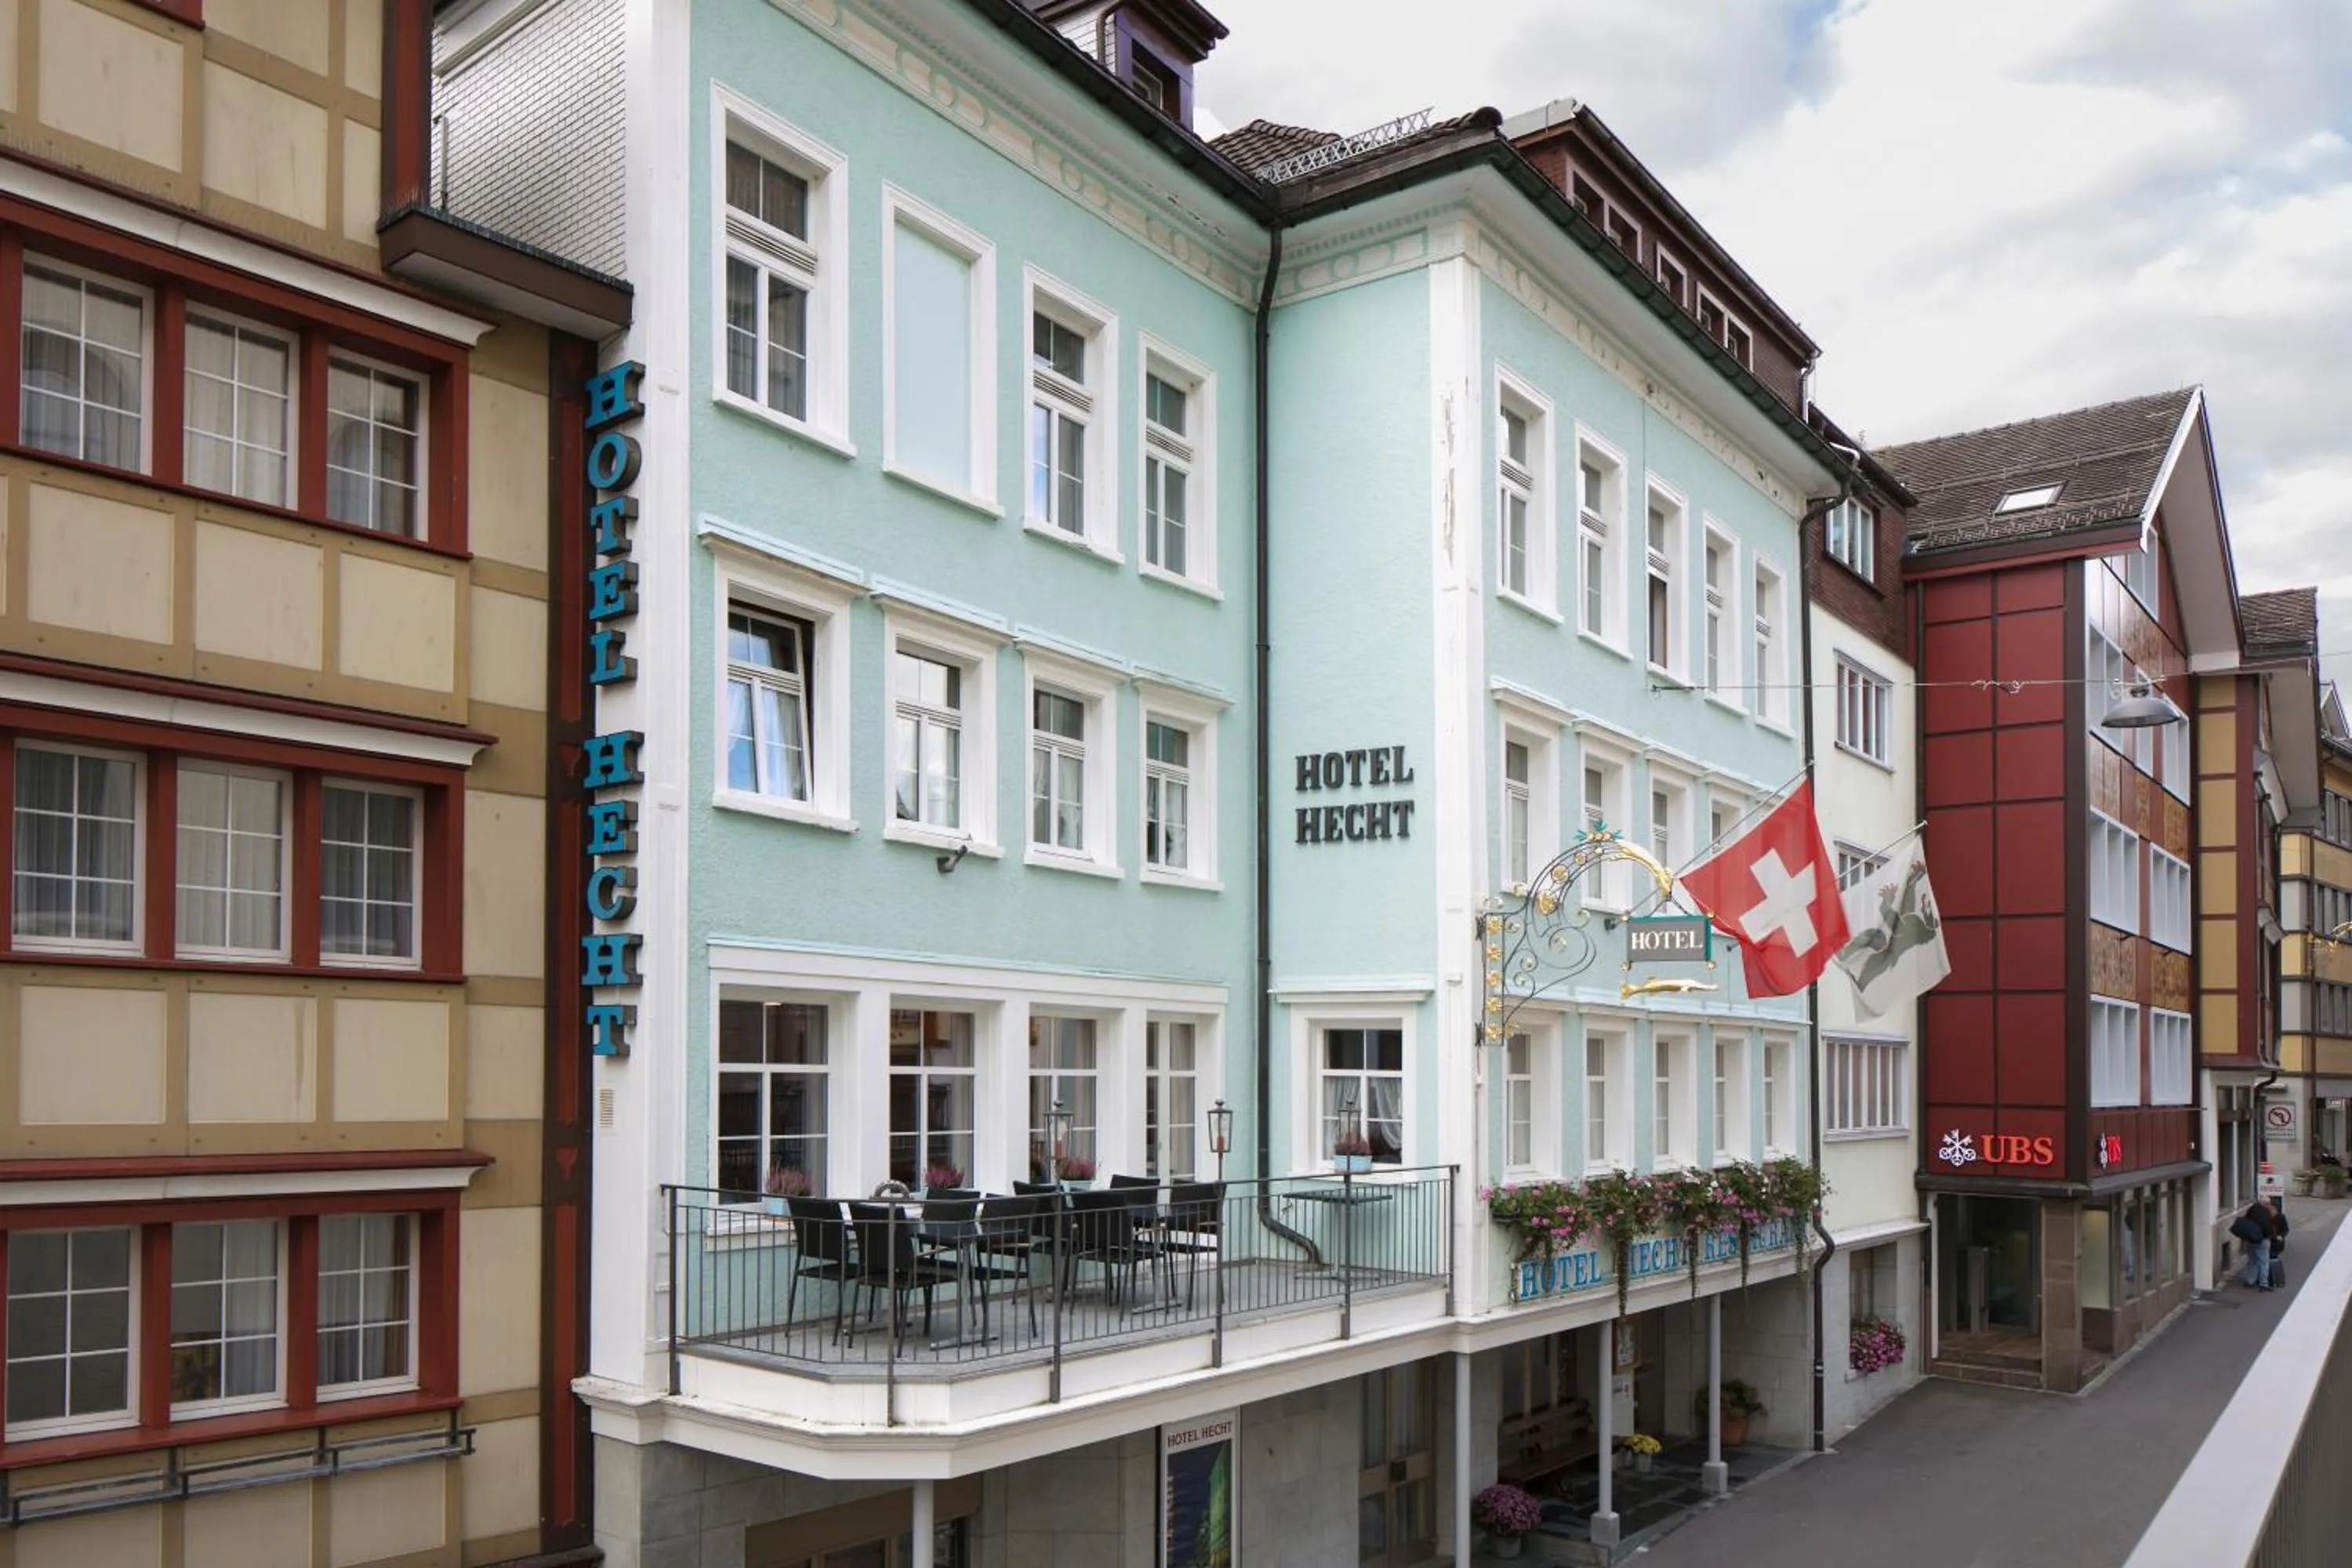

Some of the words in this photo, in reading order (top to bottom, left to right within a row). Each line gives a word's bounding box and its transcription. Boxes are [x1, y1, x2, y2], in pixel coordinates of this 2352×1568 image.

[586, 362, 645, 686] HOTEL
[1295, 746, 1414, 790] HOTEL
[1295, 800, 1414, 843] HECHT
[582, 731, 644, 1055] HECHT
[1632, 931, 1703, 950] HOTEL
[1981, 1134, 2054, 1164] UBS
[1520, 1251, 1602, 1298] HOTEL
[1167, 1429, 1199, 1447] HOTEL
[1202, 1421, 1232, 1439] HECHT
